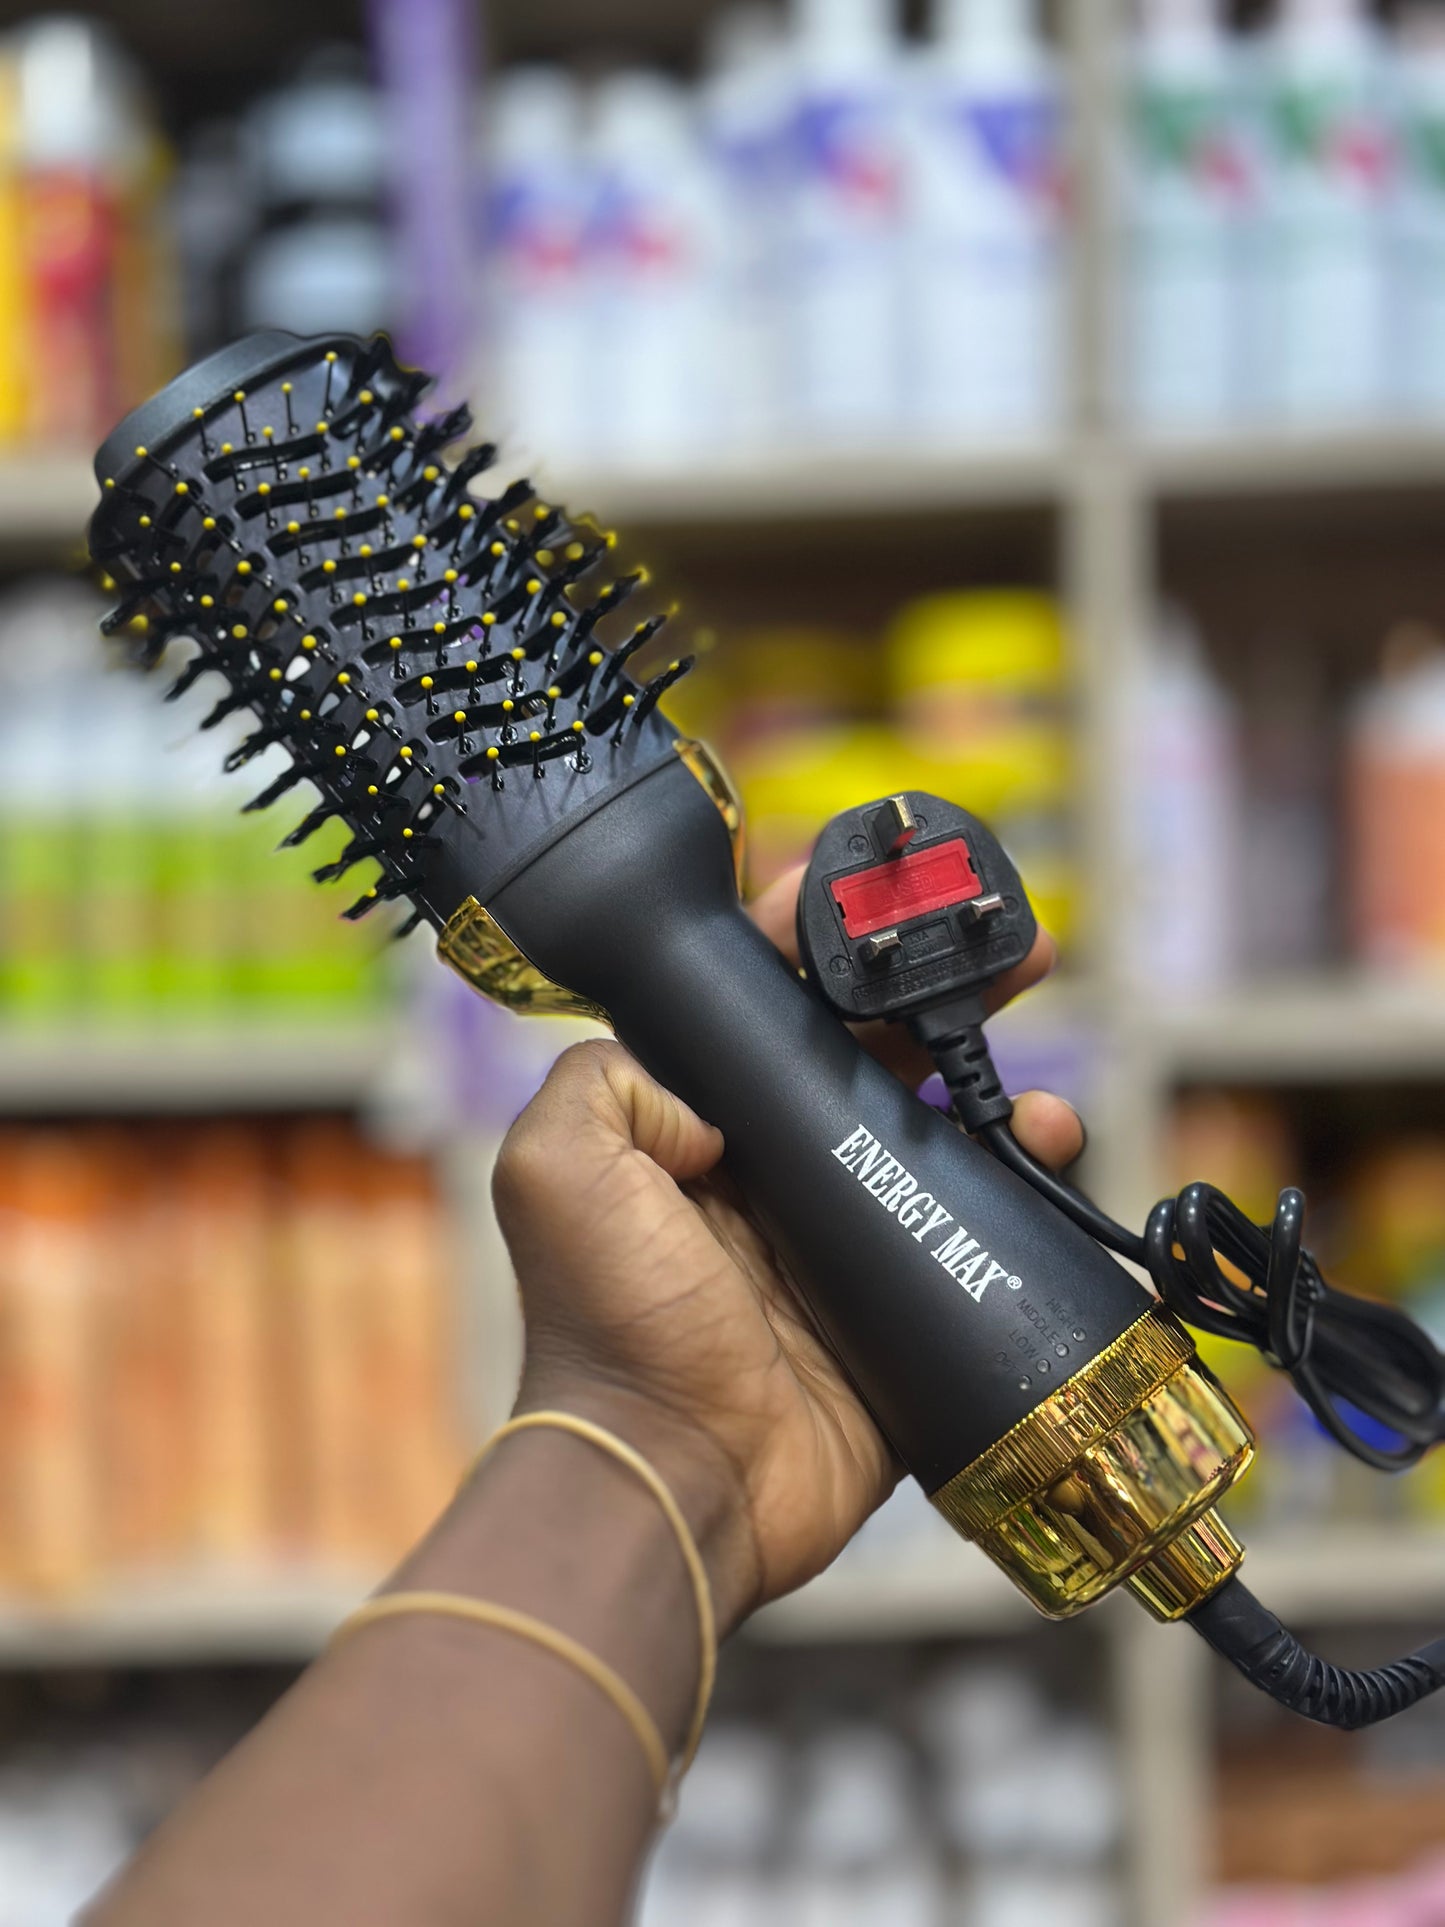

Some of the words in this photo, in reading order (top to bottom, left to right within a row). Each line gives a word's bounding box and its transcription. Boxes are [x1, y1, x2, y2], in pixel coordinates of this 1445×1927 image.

[831, 1124, 955, 1243] ENERGY
[1016, 1298, 1060, 1345] MIDDLE
[1046, 1297, 1076, 1330] HIGH
[1008, 1328, 1040, 1360] LOW
